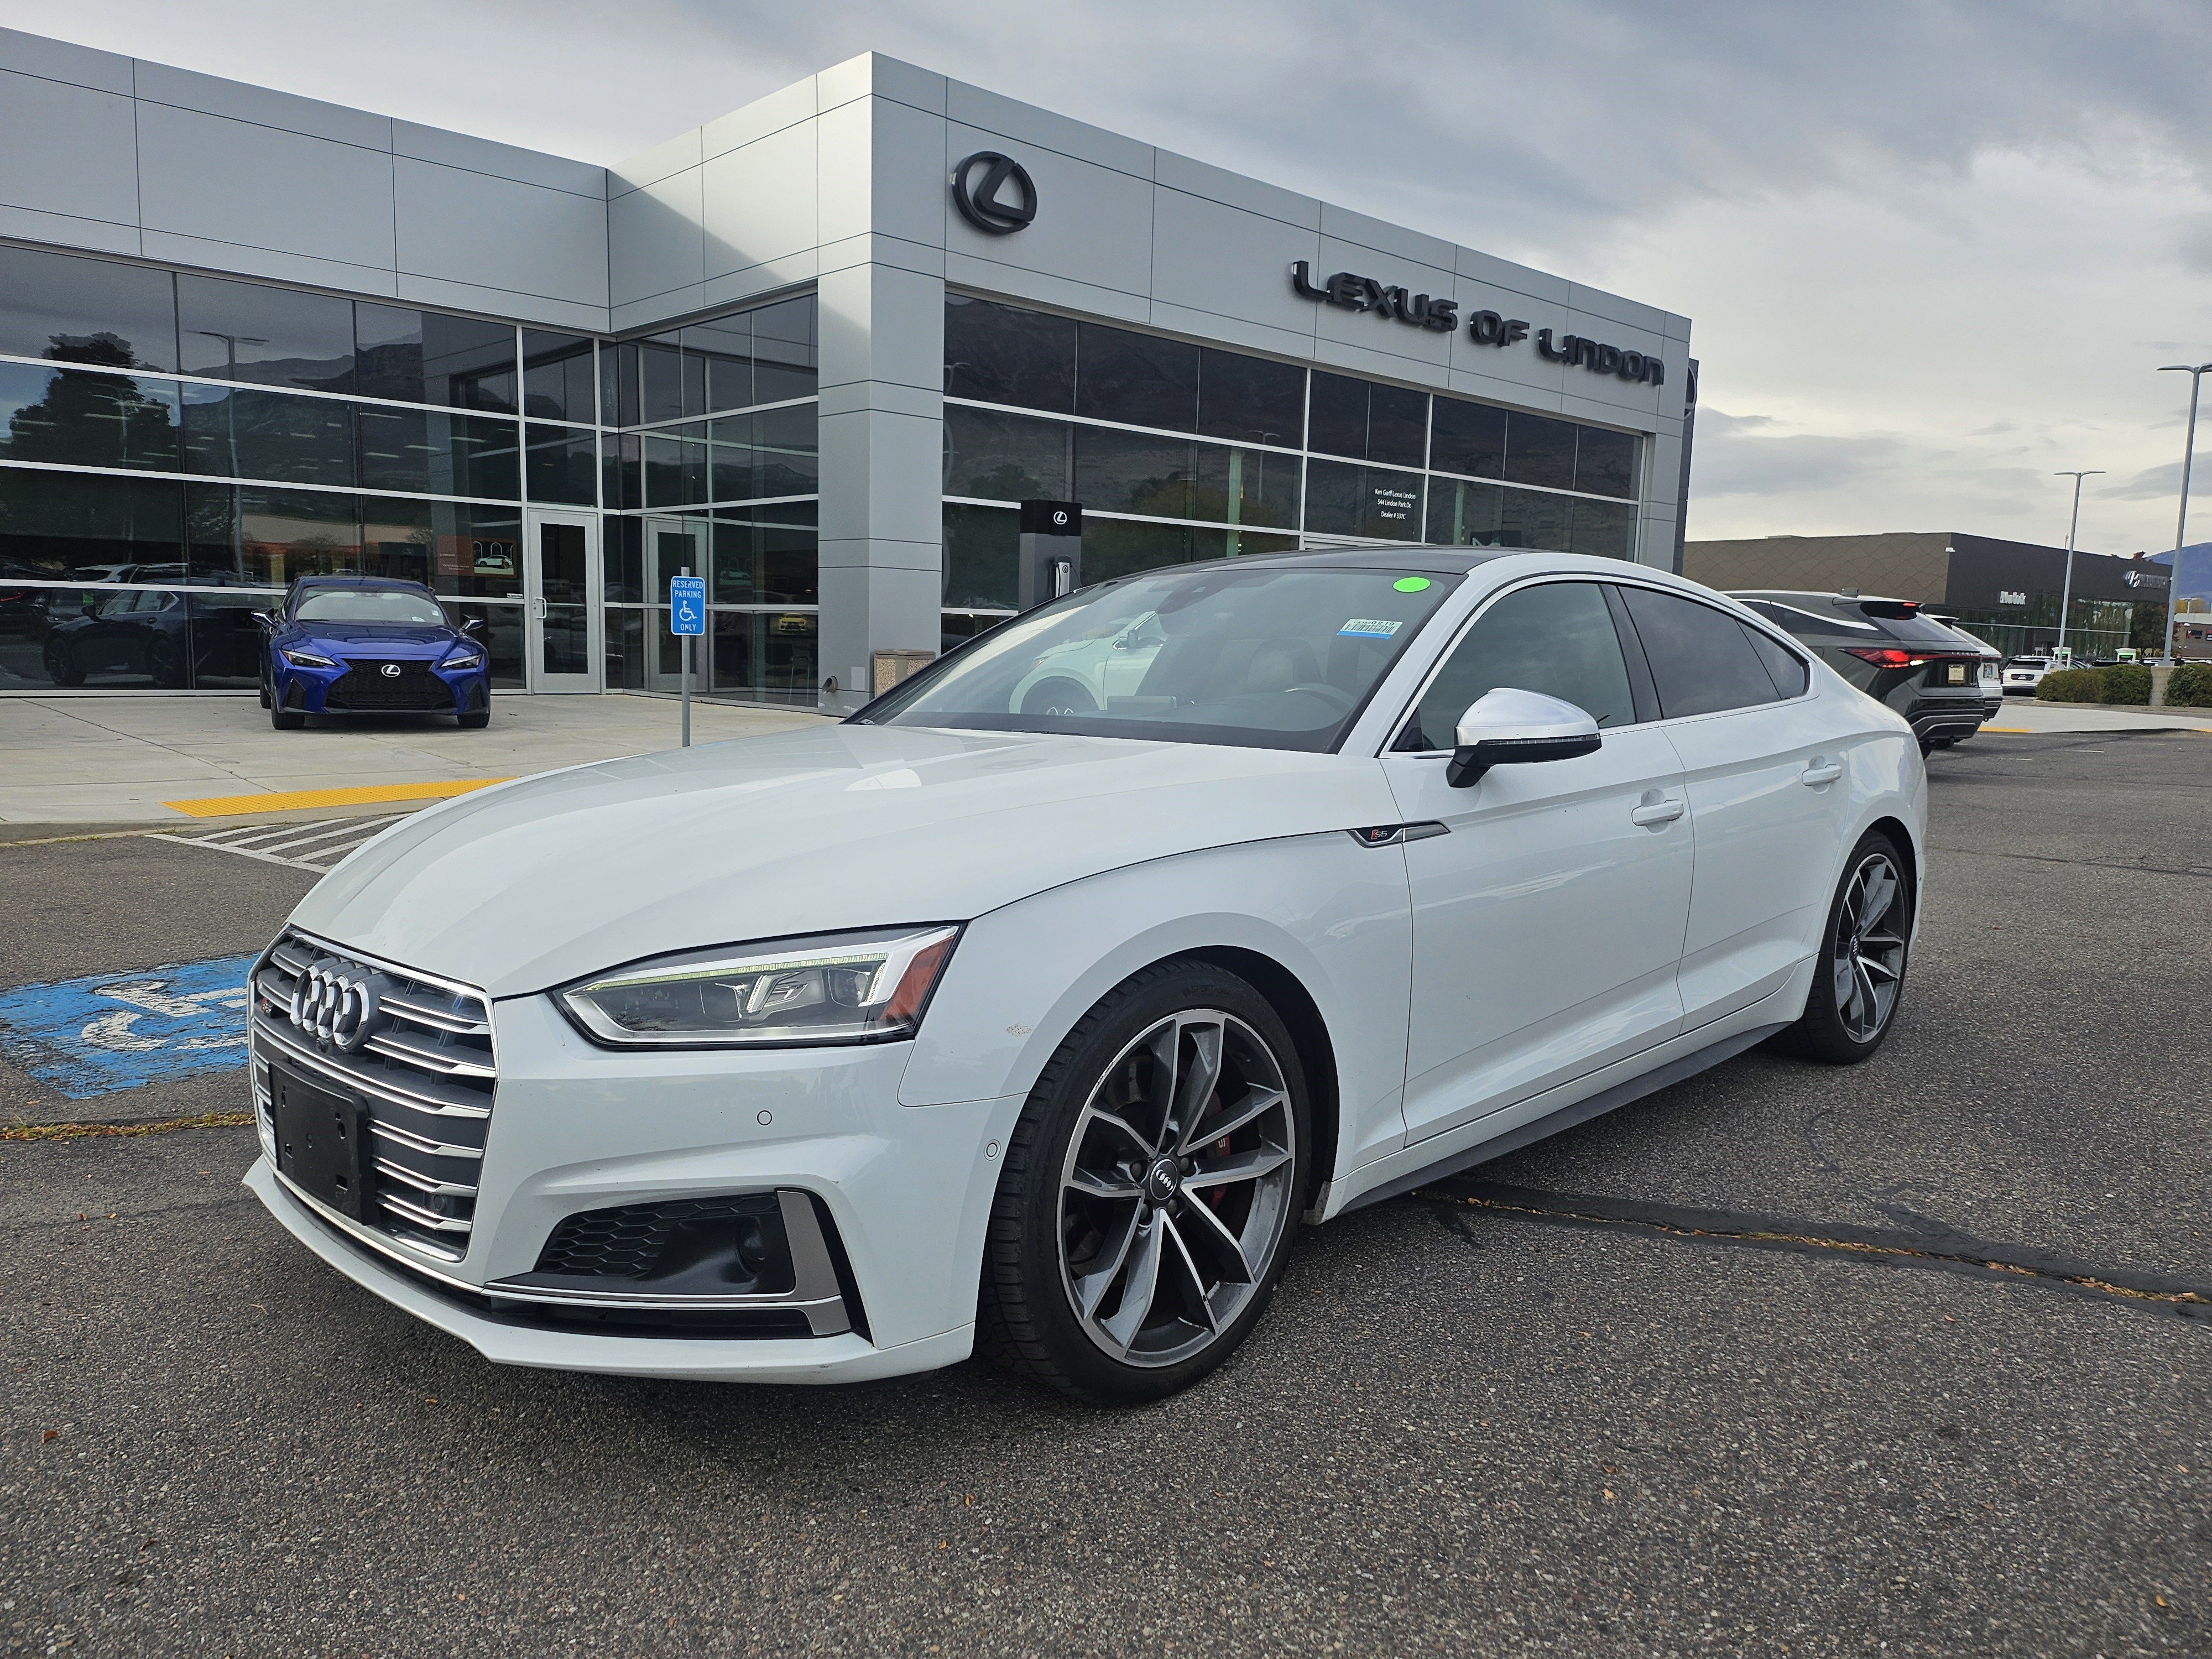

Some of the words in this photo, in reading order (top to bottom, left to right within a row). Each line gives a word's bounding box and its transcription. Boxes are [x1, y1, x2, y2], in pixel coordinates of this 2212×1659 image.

[1292, 260, 1458, 332] LEXUS
[1470, 310, 1530, 346] OF
[673, 580, 703, 588] RESERVED
[675, 590, 702, 598] PARKING
